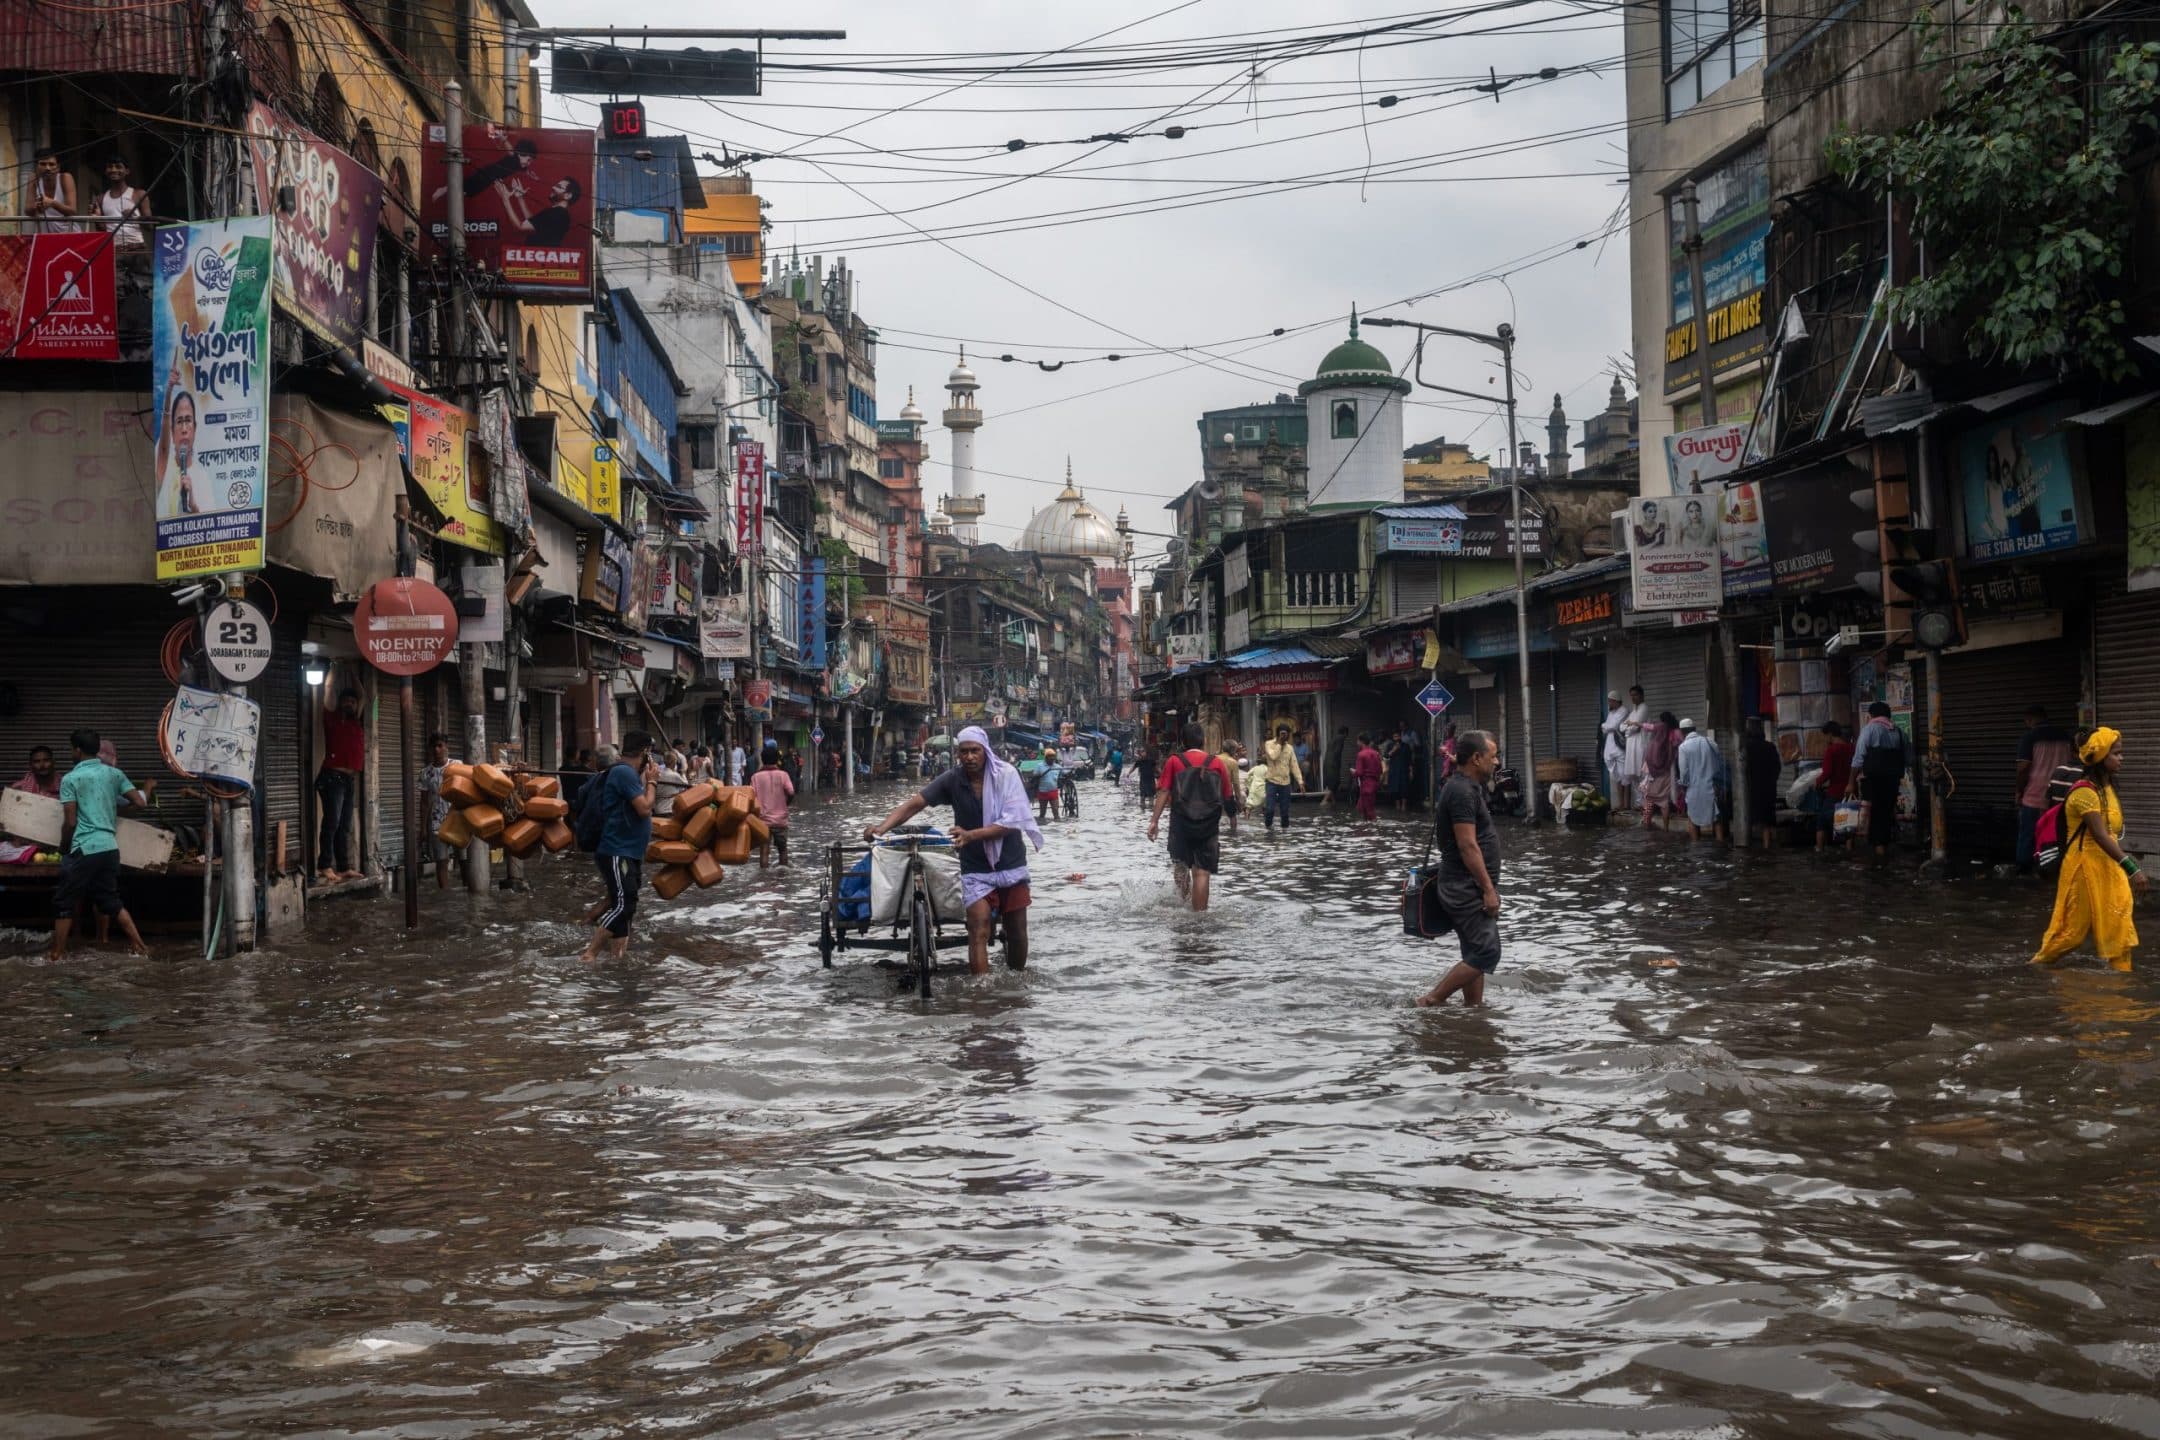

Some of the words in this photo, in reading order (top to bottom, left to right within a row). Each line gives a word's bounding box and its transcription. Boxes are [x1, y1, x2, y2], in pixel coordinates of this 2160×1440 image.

[431, 222, 498, 234] BHROSA
[163, 231, 185, 253] ২১
[505, 249, 581, 264] ELEGANT
[1665, 322, 1691, 364] FANCY
[1730, 290, 1762, 337] HOUSE
[38, 339, 69, 347] SAREES
[71, 339, 77, 347] &
[80, 339, 105, 347] STYLE
[180, 320, 257, 365] ধর্মতলা
[194, 359, 250, 402] চলো
[224, 424, 251, 442] মমতা
[198, 445, 260, 467] বন্দ্যোপাধ্যায়
[740, 443, 763, 455] NEW
[1677, 428, 1743, 463] Guruji
[159, 522, 183, 536] NORTH
[183, 517, 215, 532] KOLKATA
[216, 511, 259, 527] TRINAMOOL
[167, 532, 205, 548] CONGRESS
[206, 526, 250, 542] COMMITTEE
[1975, 543, 1992, 561] ONE
[1993, 538, 2015, 556] STAR
[2016, 532, 2047, 552] PLAZA
[160, 550, 183, 562] NORTH
[183, 546, 214, 559] KOLKATA
[216, 539, 257, 554] TRINAMOOL
[1639, 552, 1691, 561] Anniversary
[1694, 551, 1713, 559] Sale
[175, 559, 211, 572] CONGRESS
[212, 556, 222, 567] SC
[223, 553, 240, 566] CELL
[1775, 560, 1788, 577] NEW
[1816, 548, 1834, 567] HALL
[1557, 592, 1612, 625] ZEENAT
[219, 621, 258, 645] 23
[368, 638, 392, 651] NO
[393, 637, 446, 651] ENTRY
[209, 646, 243, 658] JORABAGAN
[403, 651, 411, 662] to
[1274, 671, 1302, 683] KURTA
